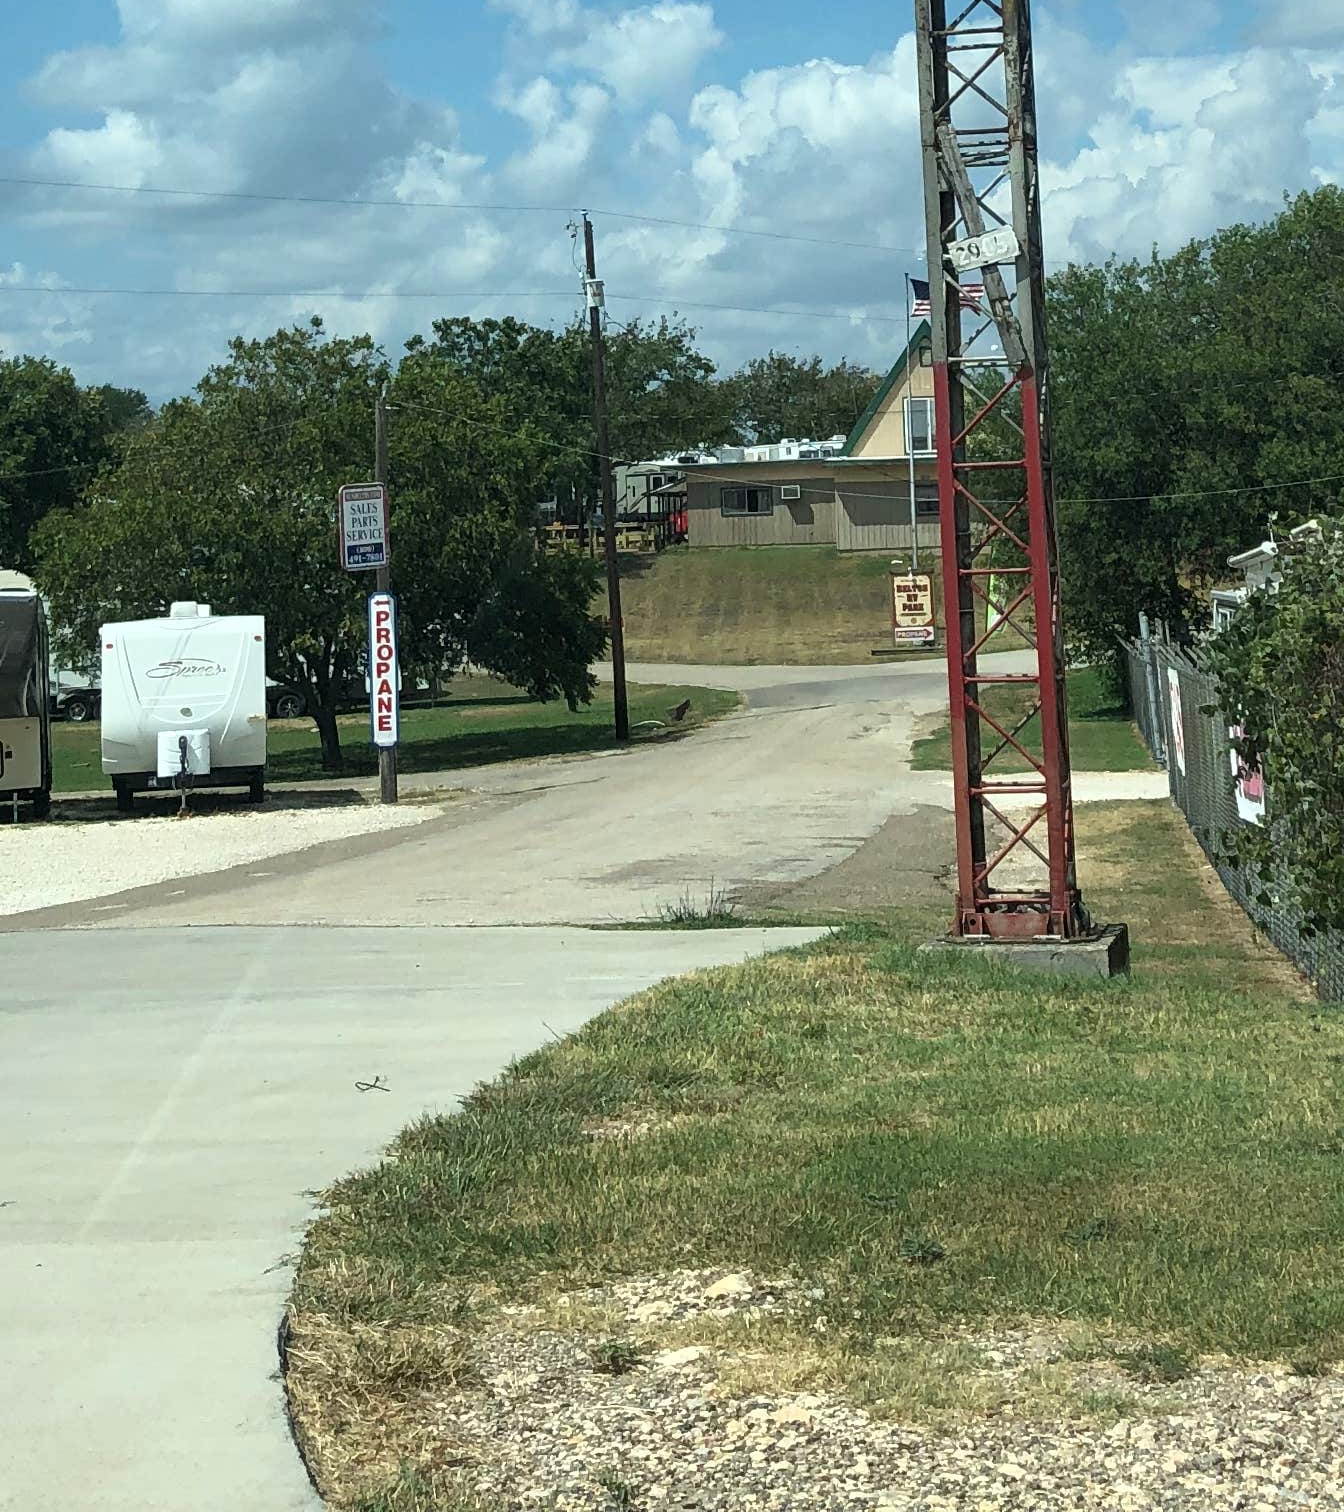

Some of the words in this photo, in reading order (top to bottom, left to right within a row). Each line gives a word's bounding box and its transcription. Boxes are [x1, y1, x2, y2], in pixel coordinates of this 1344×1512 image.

[350, 503, 378, 515] SALES
[351, 515, 378, 528] PARTS
[346, 528, 384, 542] SERVICE
[375, 610, 394, 732] PROPANE
